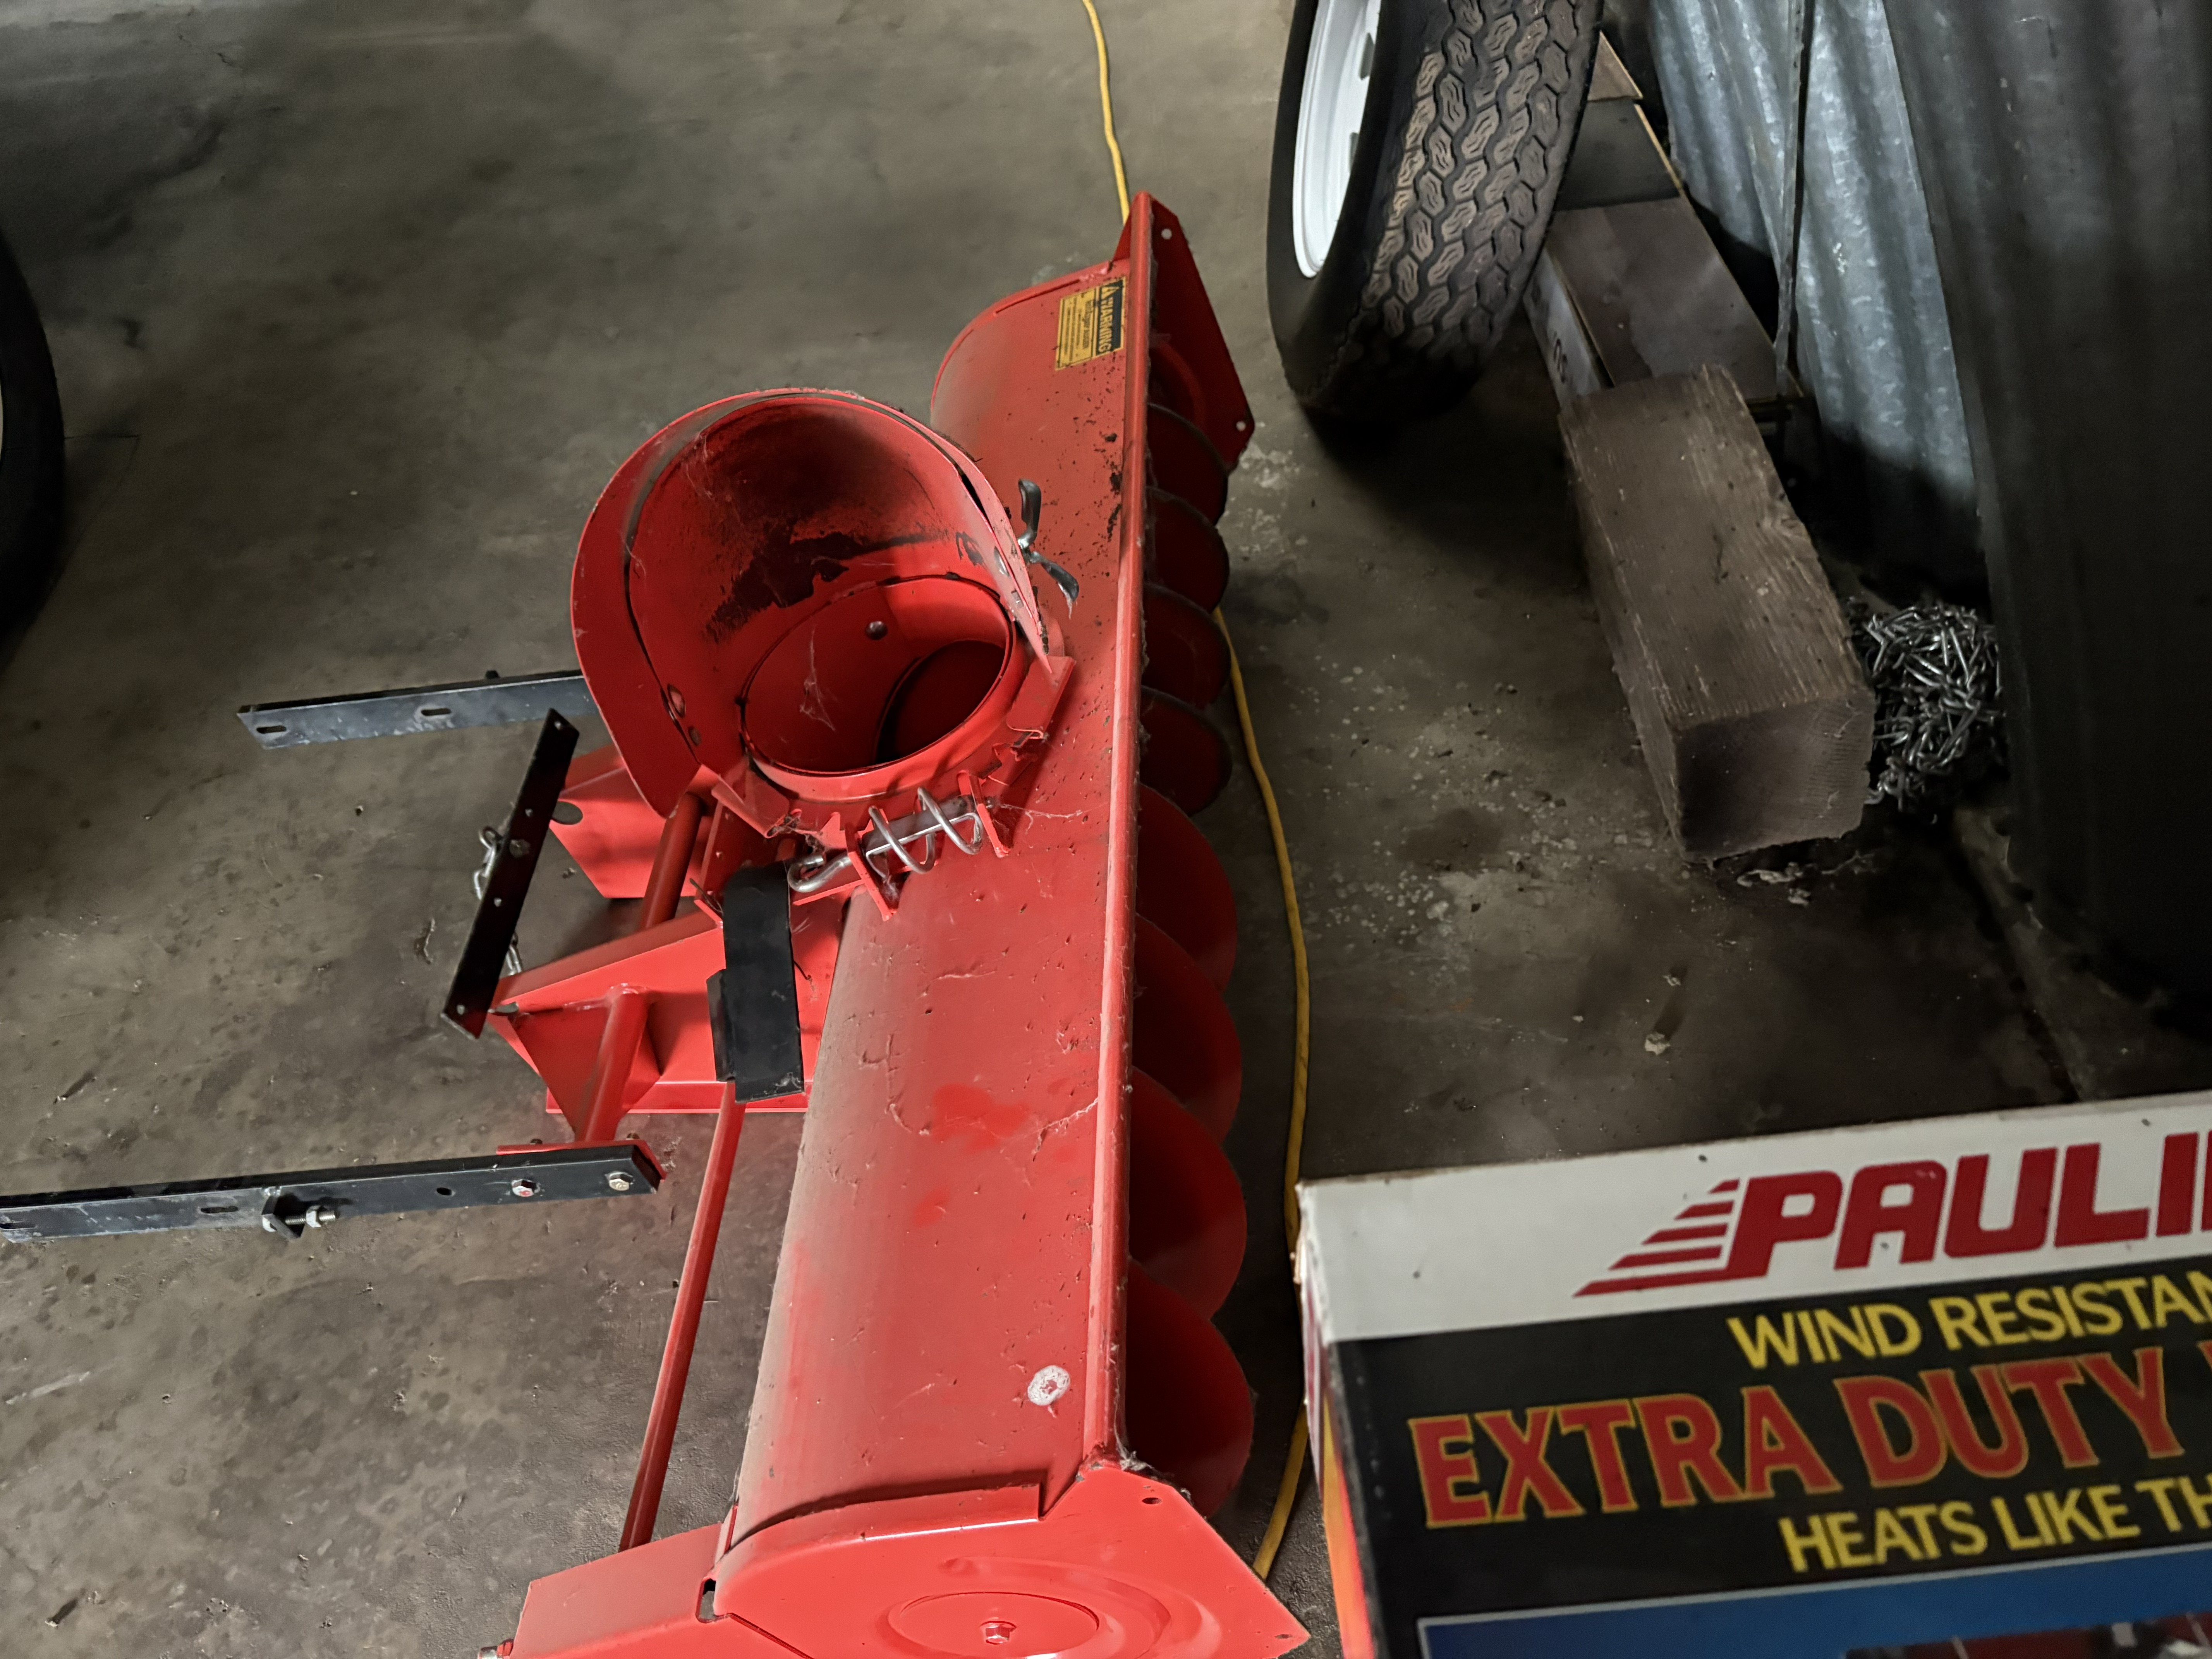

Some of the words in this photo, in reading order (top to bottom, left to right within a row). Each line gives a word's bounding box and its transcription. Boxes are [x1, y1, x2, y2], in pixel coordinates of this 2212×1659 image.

[1098, 296, 1114, 353] WARNING
[1719, 1129, 2212, 1277] PAULI
[1726, 1304, 1922, 1369] WIND
[1407, 1385, 1843, 1528] EXTRA
[1832, 1345, 2186, 1489] DUTY
[1778, 1499, 1989, 1573] HEATS
[1990, 1484, 2142, 1551] LIKE
